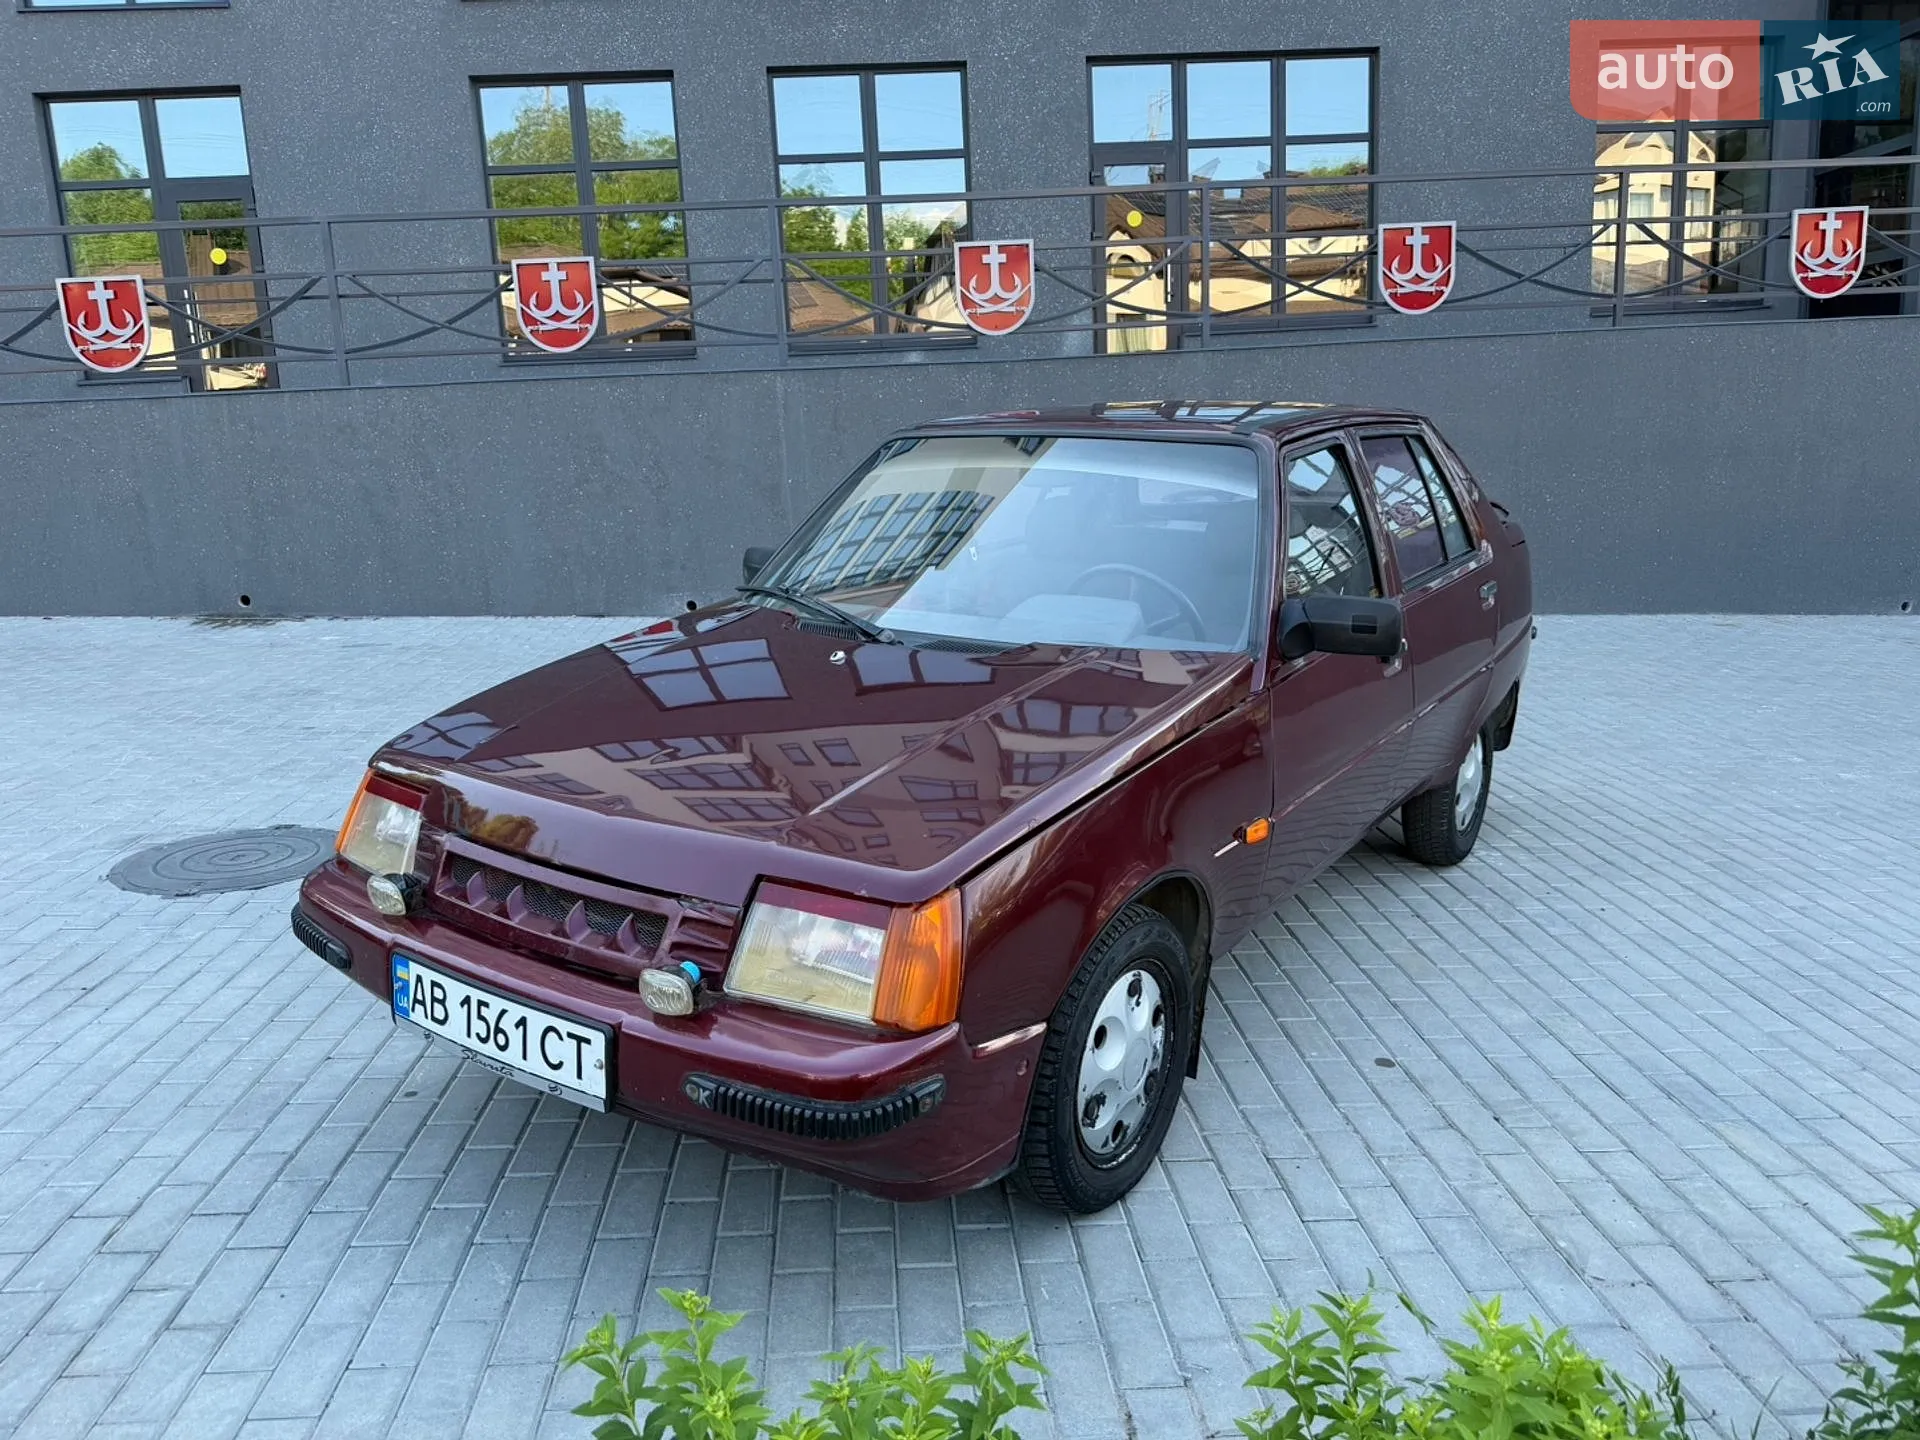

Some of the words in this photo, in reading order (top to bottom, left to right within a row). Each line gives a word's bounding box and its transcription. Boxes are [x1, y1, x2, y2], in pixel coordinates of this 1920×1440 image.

[397, 993, 409, 1009] UA
[411, 974, 449, 1026] AB
[459, 995, 527, 1061] 1561
[540, 1025, 592, 1080] CT
